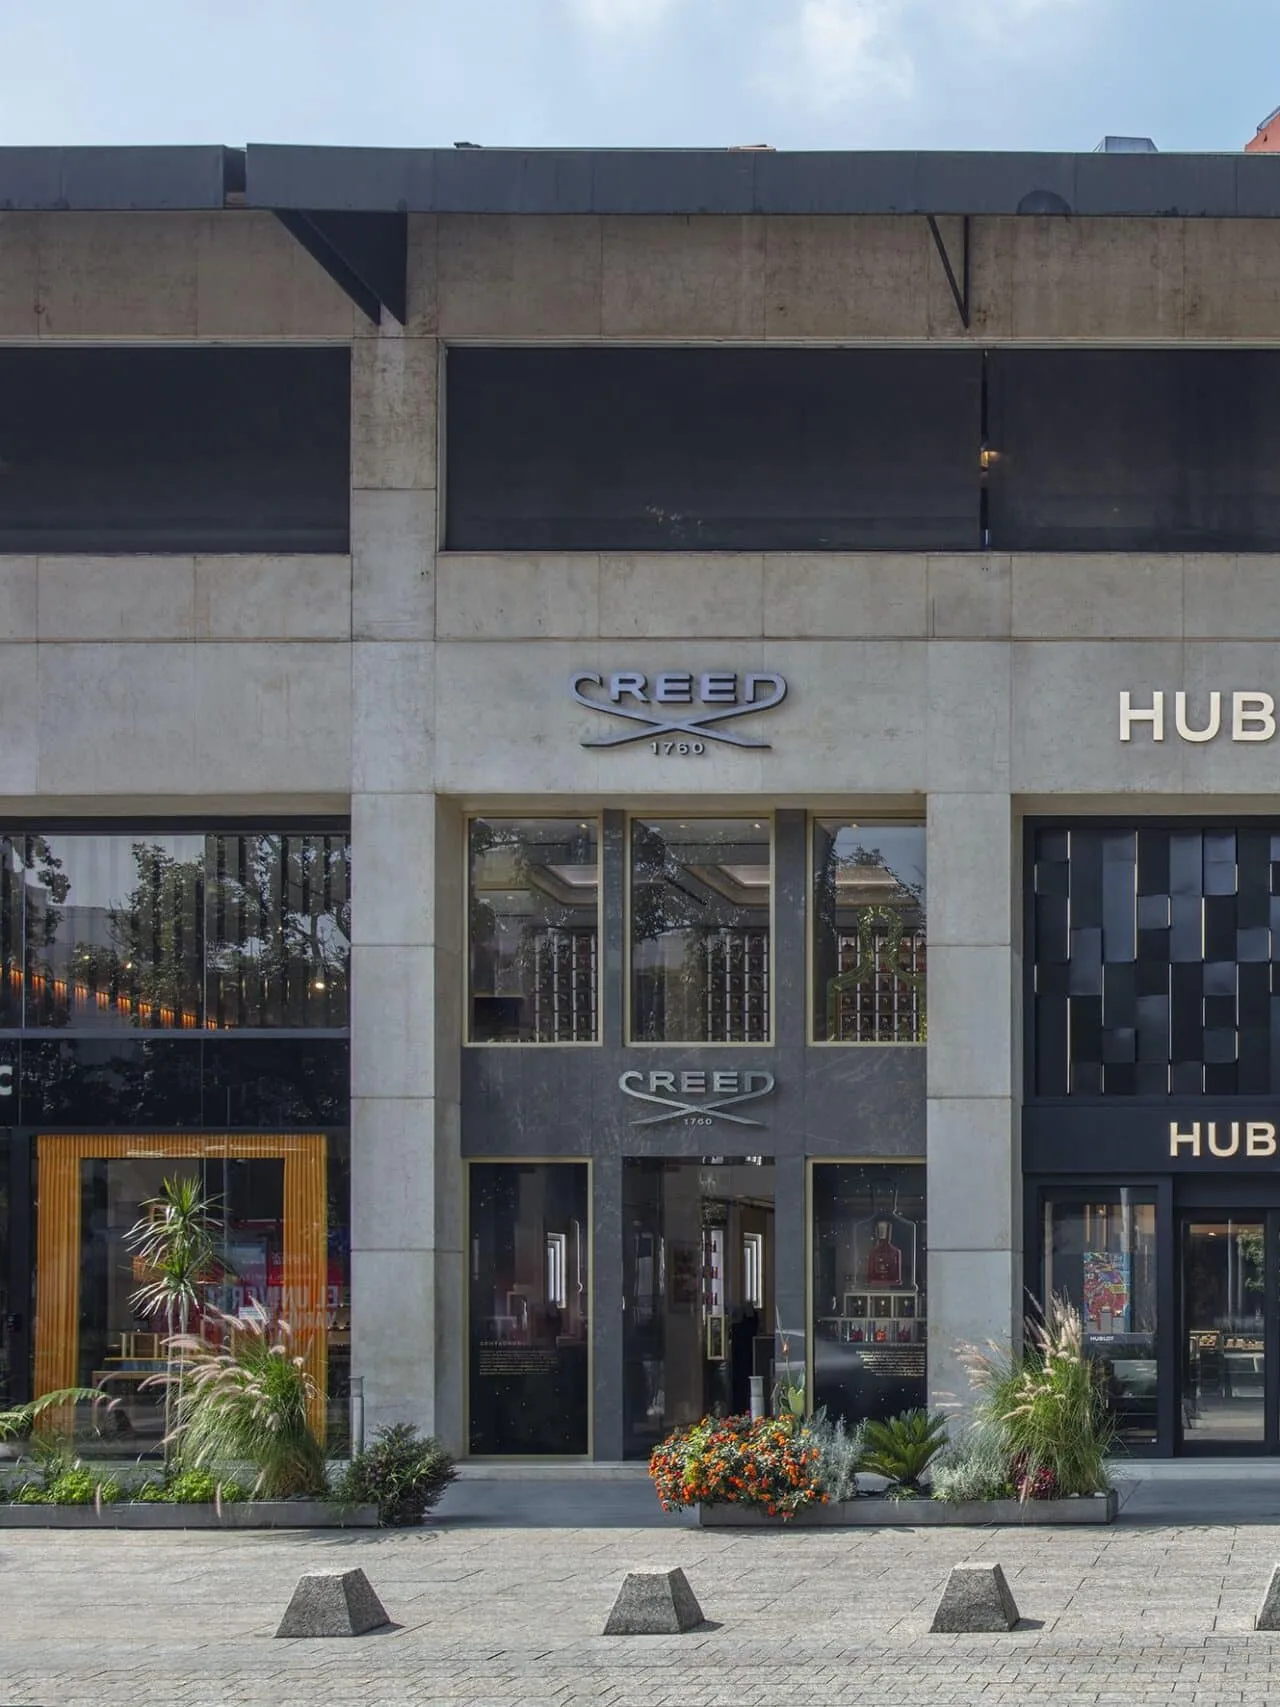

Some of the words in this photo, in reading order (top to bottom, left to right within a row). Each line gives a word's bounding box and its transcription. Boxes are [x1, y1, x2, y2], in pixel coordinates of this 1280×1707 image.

[570, 671, 788, 712] CREED
[650, 741, 705, 755] 1760
[618, 1070, 775, 1099] CREED
[684, 1117, 713, 1126] 1760
